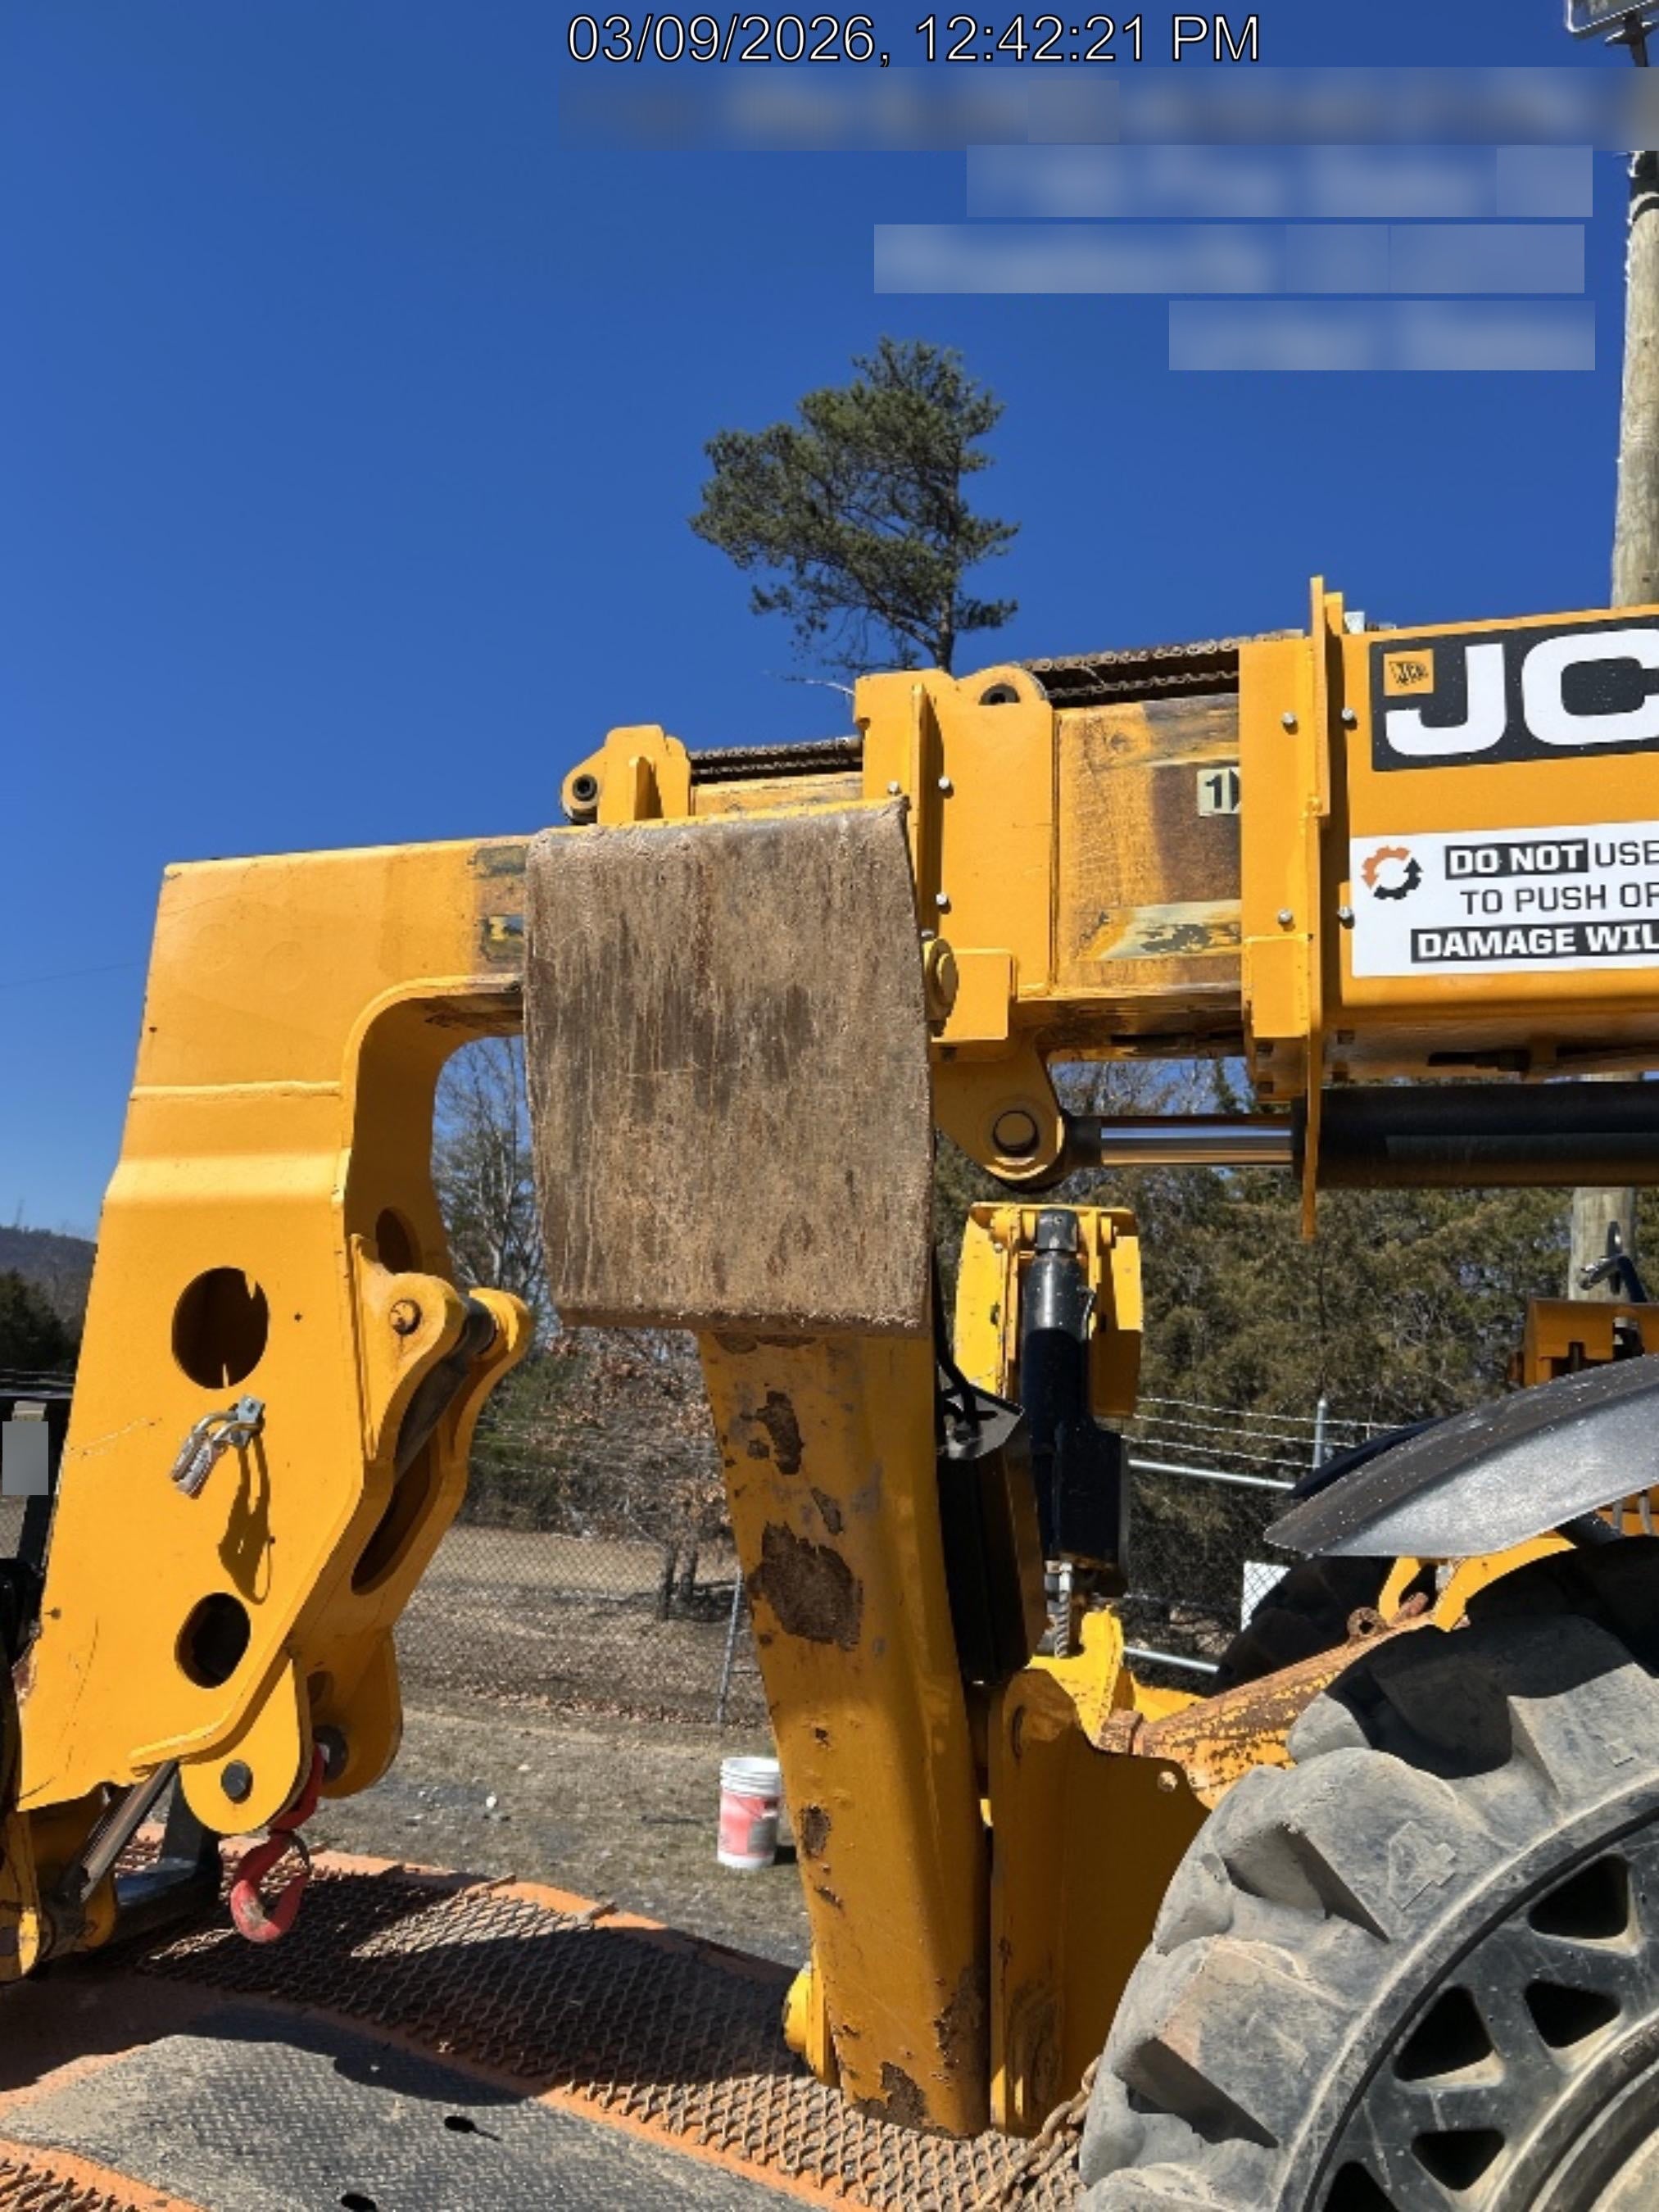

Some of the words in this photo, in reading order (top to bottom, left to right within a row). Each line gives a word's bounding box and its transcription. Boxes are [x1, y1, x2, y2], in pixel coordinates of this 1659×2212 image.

[1449, 847, 1499, 875] DO
[1509, 845, 1584, 871] NOT
[1594, 840, 1659, 868] USE
[1460, 888, 1503, 914] TO
[1516, 884, 1606, 912] PUSH
[1417, 927, 1577, 959] DAMAGE
